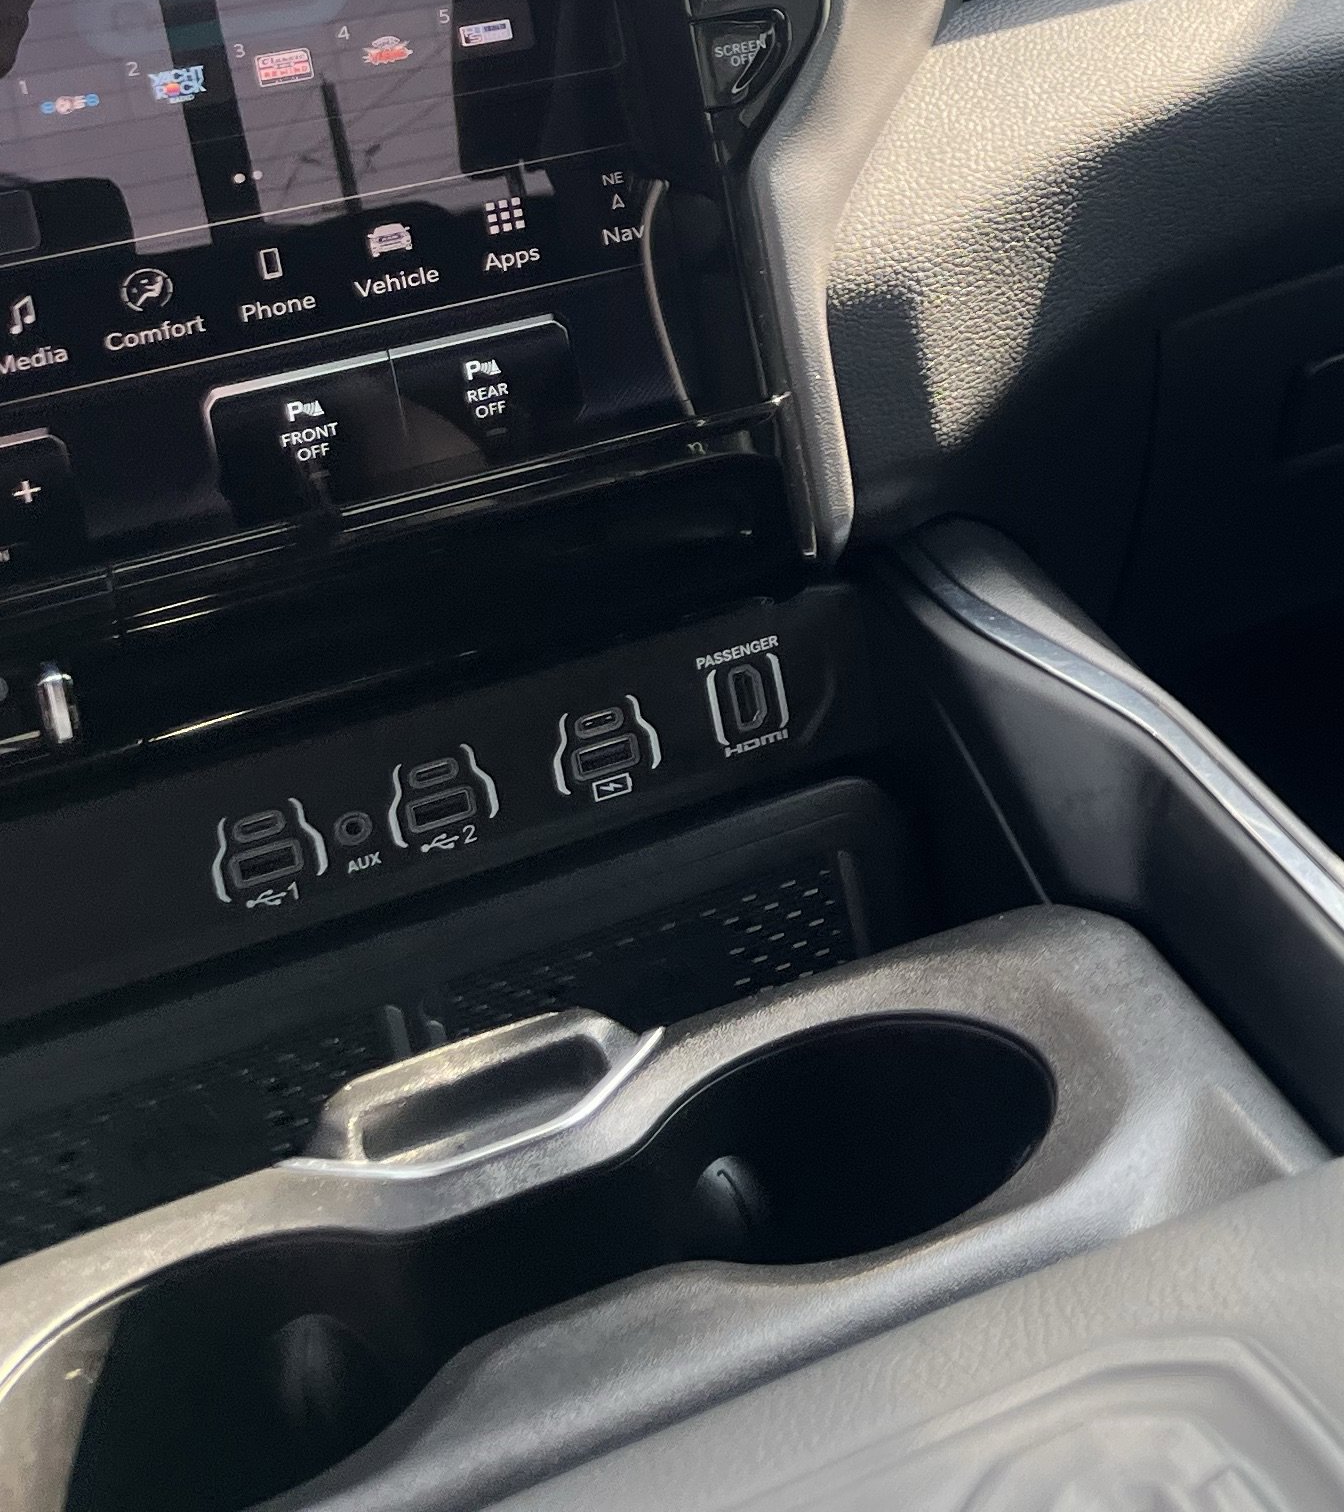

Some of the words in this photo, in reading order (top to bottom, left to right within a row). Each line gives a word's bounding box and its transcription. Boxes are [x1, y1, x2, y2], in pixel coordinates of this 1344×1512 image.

[438, 8, 450, 24] 5
[337, 25, 351, 41] 4
[233, 43, 246, 58] 3
[714, 39, 767, 58] SCREEN
[126, 61, 140, 77] 2
[731, 52, 757, 67] OFF
[19, 80, 29, 95] 1
[602, 171, 624, 186] NE
[602, 224, 645, 246] Nav
[484, 247, 541, 272] Apps
[354, 266, 440, 298] Vehicle
[239, 294, 316, 323] Phone
[104, 315, 207, 351] Comfort
[0, 345, 69, 375] Media
[467, 383, 509, 403] REAR
[475, 401, 507, 419] OFF
[279, 422, 338, 448] FRONT
[296, 442, 330, 462] OFF
[695, 635, 779, 670] PASSENGER
[724, 728, 789, 758] HDMI
[462, 825, 478, 844] 2
[348, 851, 382, 874] AUX
[287, 881, 299, 900] 1
